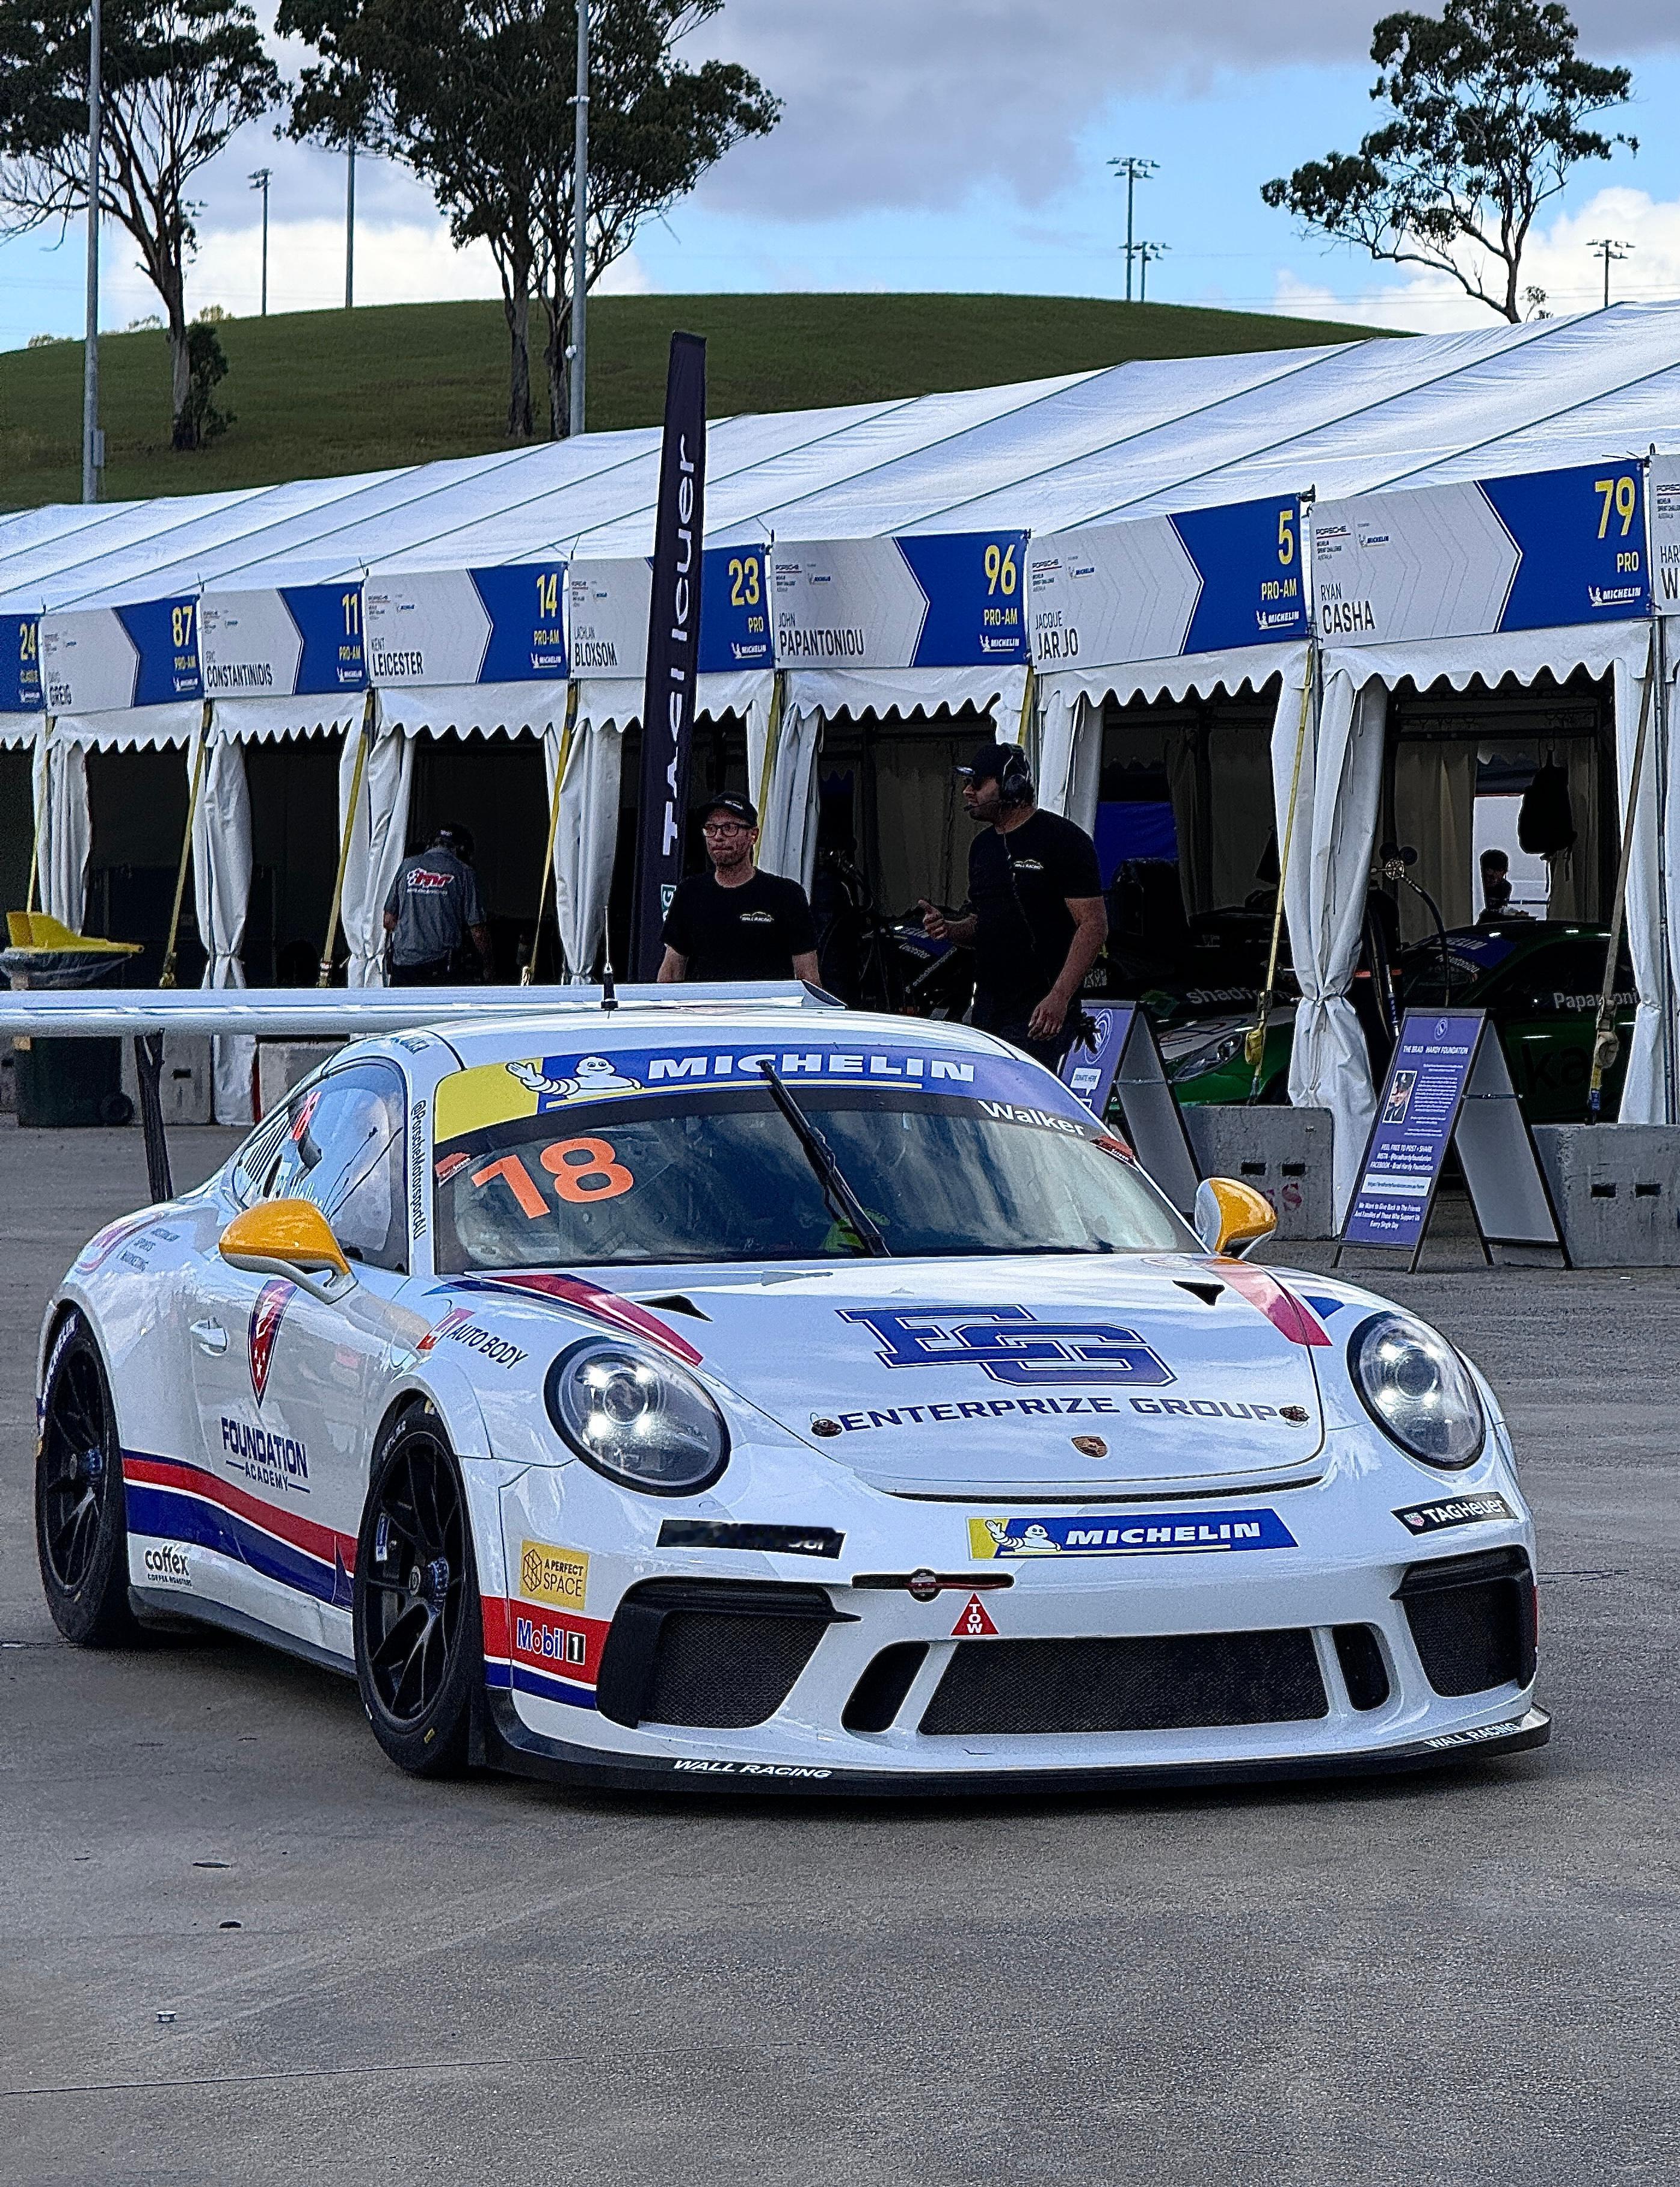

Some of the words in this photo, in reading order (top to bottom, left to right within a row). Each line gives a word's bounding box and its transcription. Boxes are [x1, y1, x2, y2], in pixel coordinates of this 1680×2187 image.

[1595, 477, 1635, 539] 79
[1278, 510, 1294, 565] 5
[1315, 525, 1347, 535] PORSCHE
[1616, 551, 1639, 573] PRO
[1660, 544, 1680, 564] HAR
[728, 557, 760, 606] 23
[984, 544, 1015, 596] 96
[537, 573, 558, 618] 14
[1261, 578, 1297, 601] PRO-AM
[1320, 582, 1342, 601] RYAN
[1602, 586, 1642, 600] MICHELIN
[172, 605, 193, 647] 87
[342, 593, 358, 635] 11
[748, 615, 764, 633] PRO
[778, 612, 796, 629] JOHN
[983, 608, 1018, 626] PRO-AM
[1035, 611, 1063, 630] JACQUE
[1268, 611, 1300, 624] MICHELIN
[1322, 600, 1376, 635] CASHA
[20, 623, 37, 661] 24
[534, 629, 560, 647] PRO-AM
[741, 644, 767, 654] MICHELIN
[778, 629, 864, 656] PAPANTONIOU
[991, 638, 1020, 647] MICHELIN
[372, 651, 423, 676] LEICESTER
[575, 642, 618, 667] BLOXSOM
[206, 663, 273, 687] CONSTANTINIDIS
[648, 1054, 974, 1082] MICHELIN
[978, 1100, 1085, 1137] Walker
[471, 1137, 633, 1219] 18
[446, 1323, 489, 1347] AUTO
[478, 1336, 529, 1370] BODY
[838, 1397, 1122, 1432] ENTERPRIZE
[1128, 1398, 1281, 1421] GROUP
[221, 1416, 309, 1478] FOUNDATION
[244, 1461, 289, 1492] ACADEMY
[1421, 1500, 1506, 1523] TAGHeuer
[1066, 1522, 1261, 1545] MICHELIN
[144, 1545, 190, 1576] coffex
[545, 1558, 550, 1569] A
[551, 1559, 584, 1576] PERFECT
[543, 1572, 583, 1597] SPACE
[967, 1603, 983, 1634] TOW
[517, 1617, 564, 1661] Mobil
[1424, 1733, 1468, 1749] WALL
[1472, 1721, 1522, 1741] RACING
[673, 1759, 736, 1774] WALL
[739, 1765, 833, 1780] RACING
